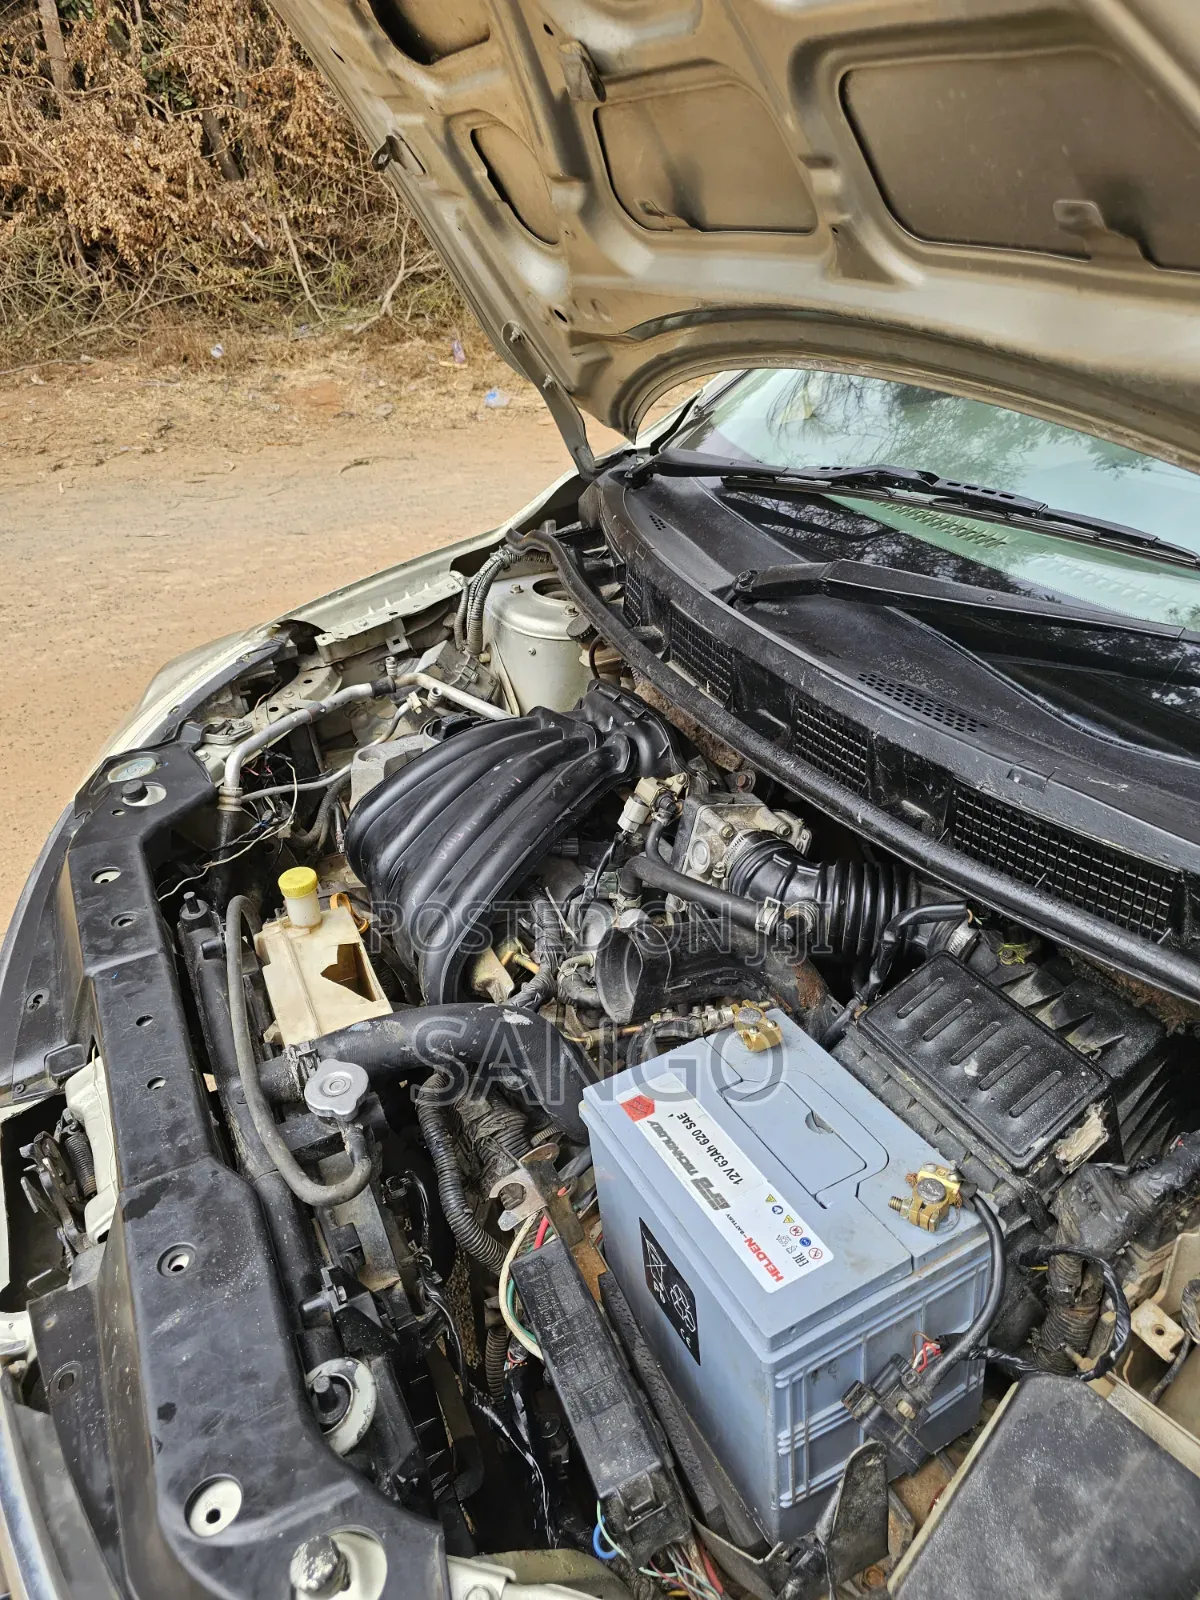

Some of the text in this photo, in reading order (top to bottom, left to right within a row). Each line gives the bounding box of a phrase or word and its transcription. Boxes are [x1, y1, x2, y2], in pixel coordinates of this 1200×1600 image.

[646, 1120, 699, 1177] TECHNOLOGY
[676, 1111, 744, 1185] 12V 63Ah 620 SAE
